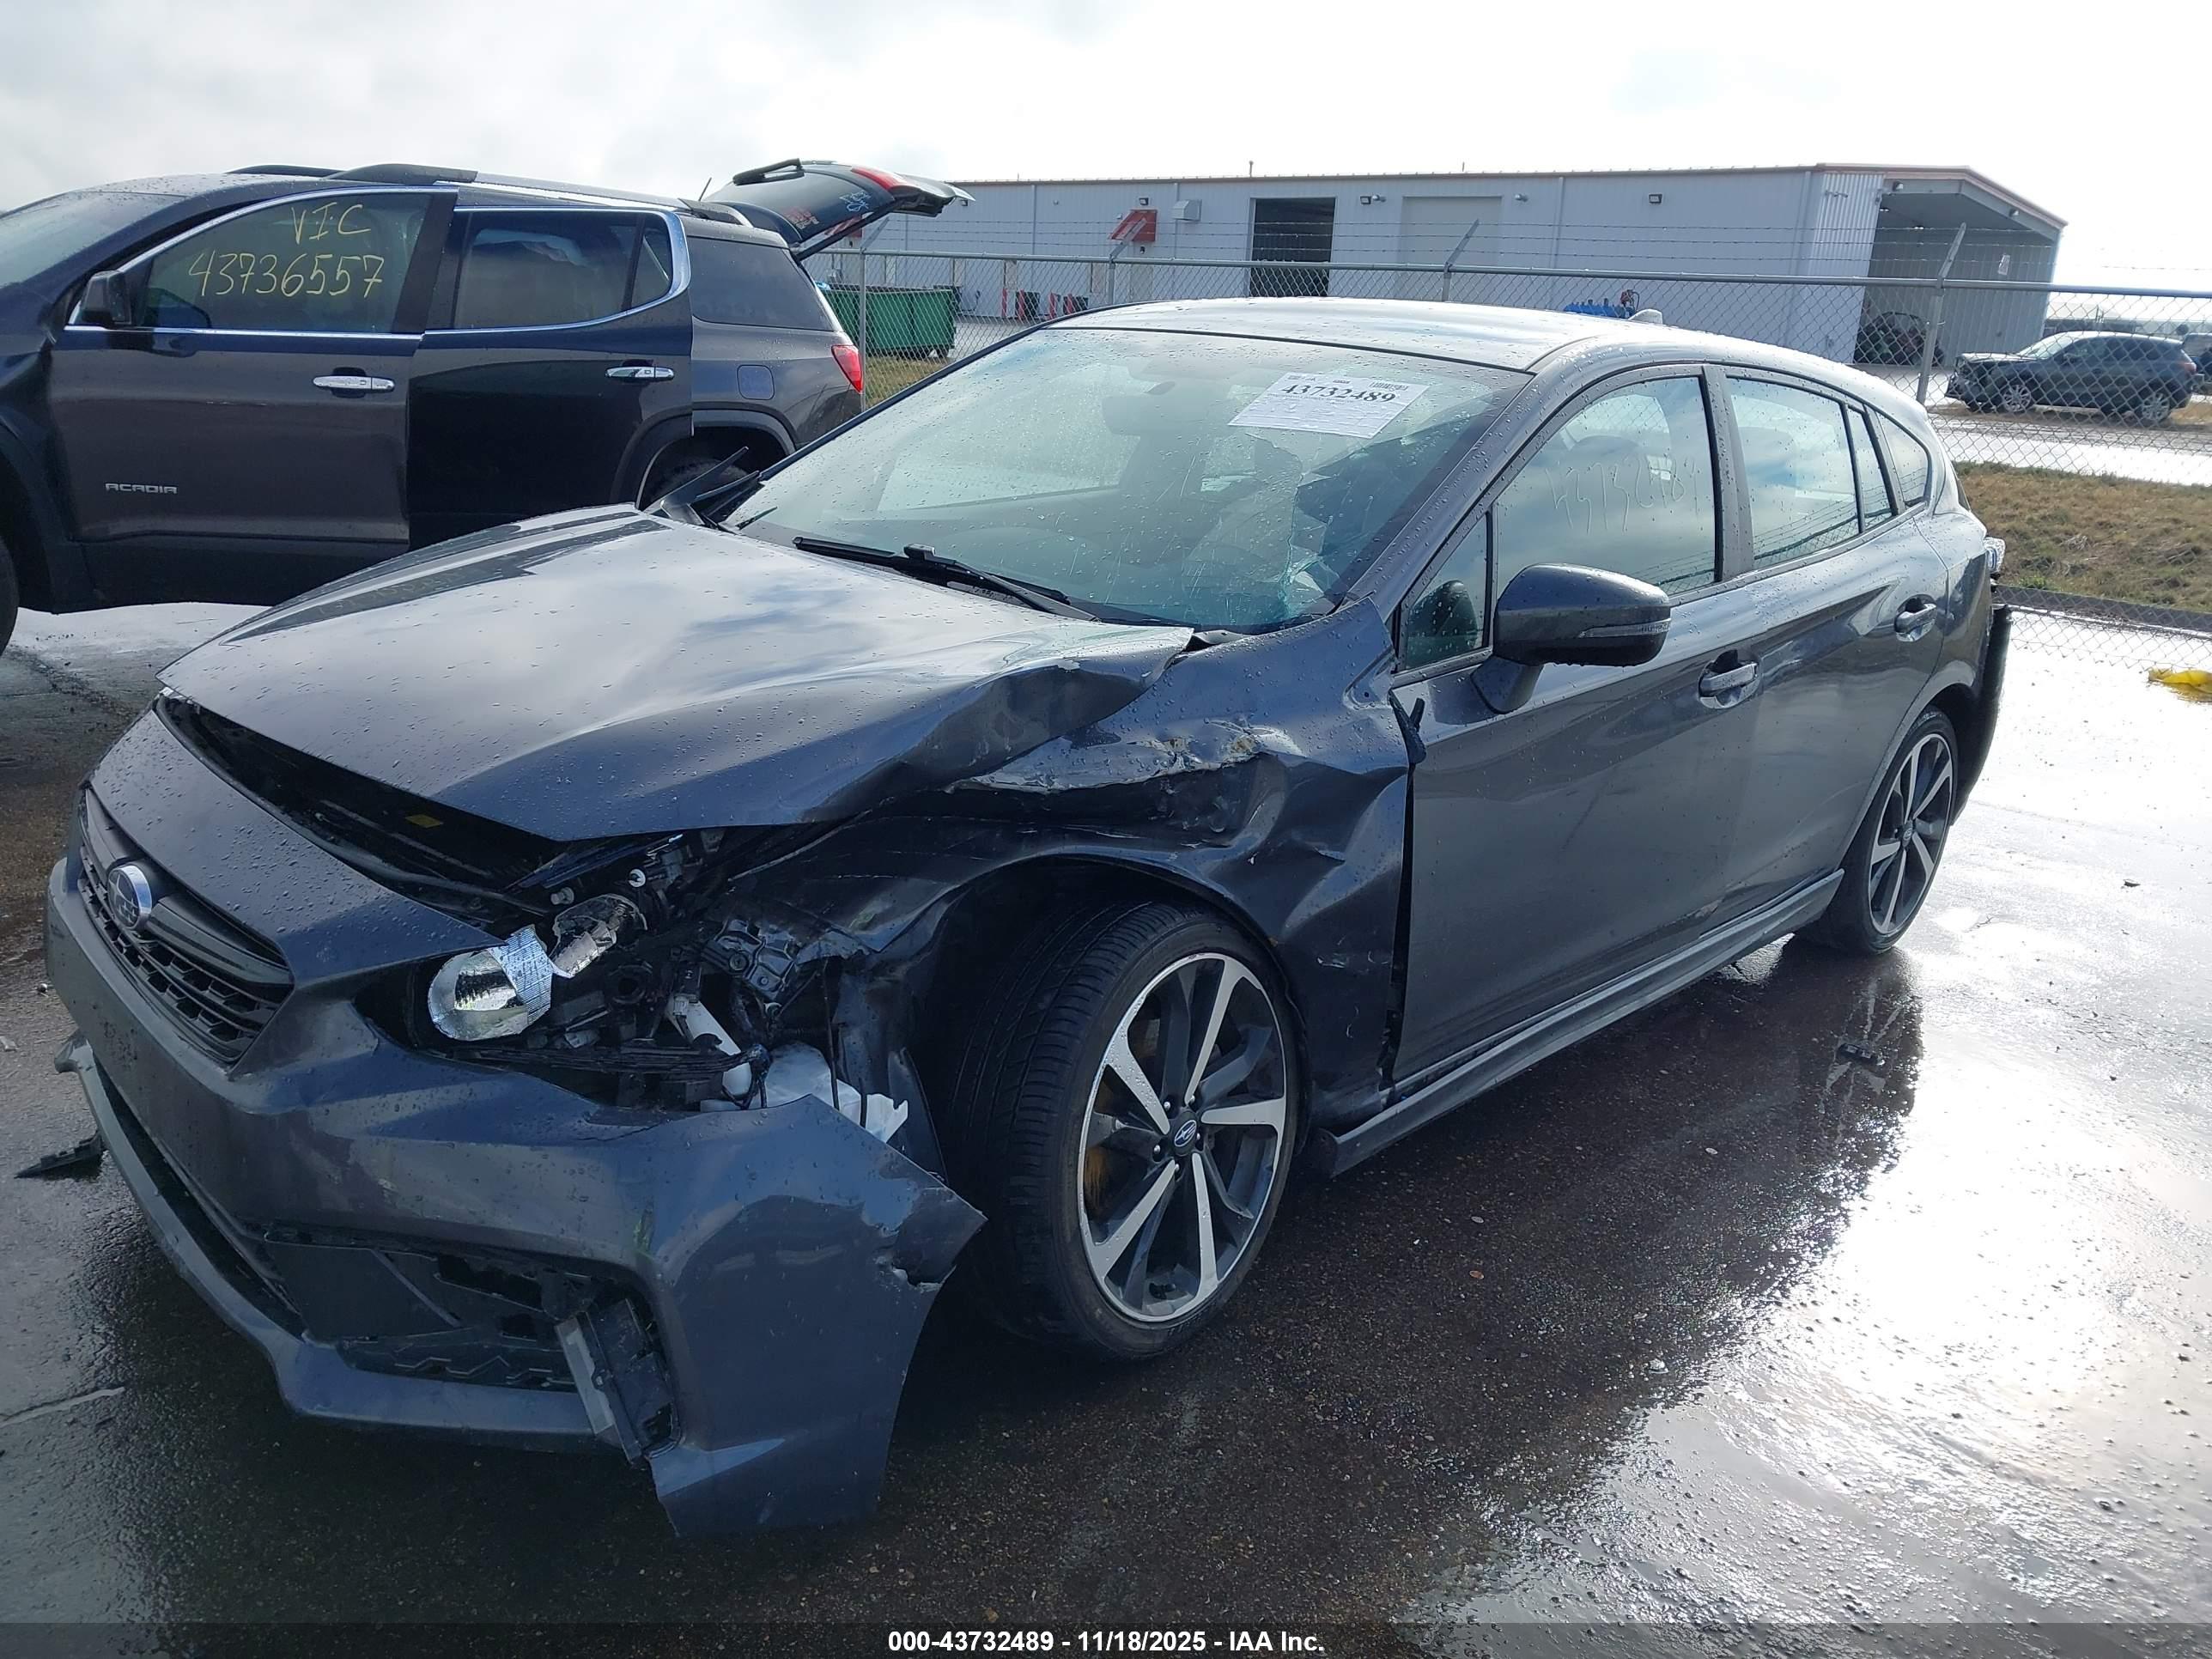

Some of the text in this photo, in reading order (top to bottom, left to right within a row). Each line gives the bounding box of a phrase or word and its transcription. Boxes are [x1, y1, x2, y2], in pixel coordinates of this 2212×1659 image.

[188, 251, 385, 298] 43736557
[1281, 383, 1397, 403] 43732489
[105, 483, 178, 495] ACADIA
